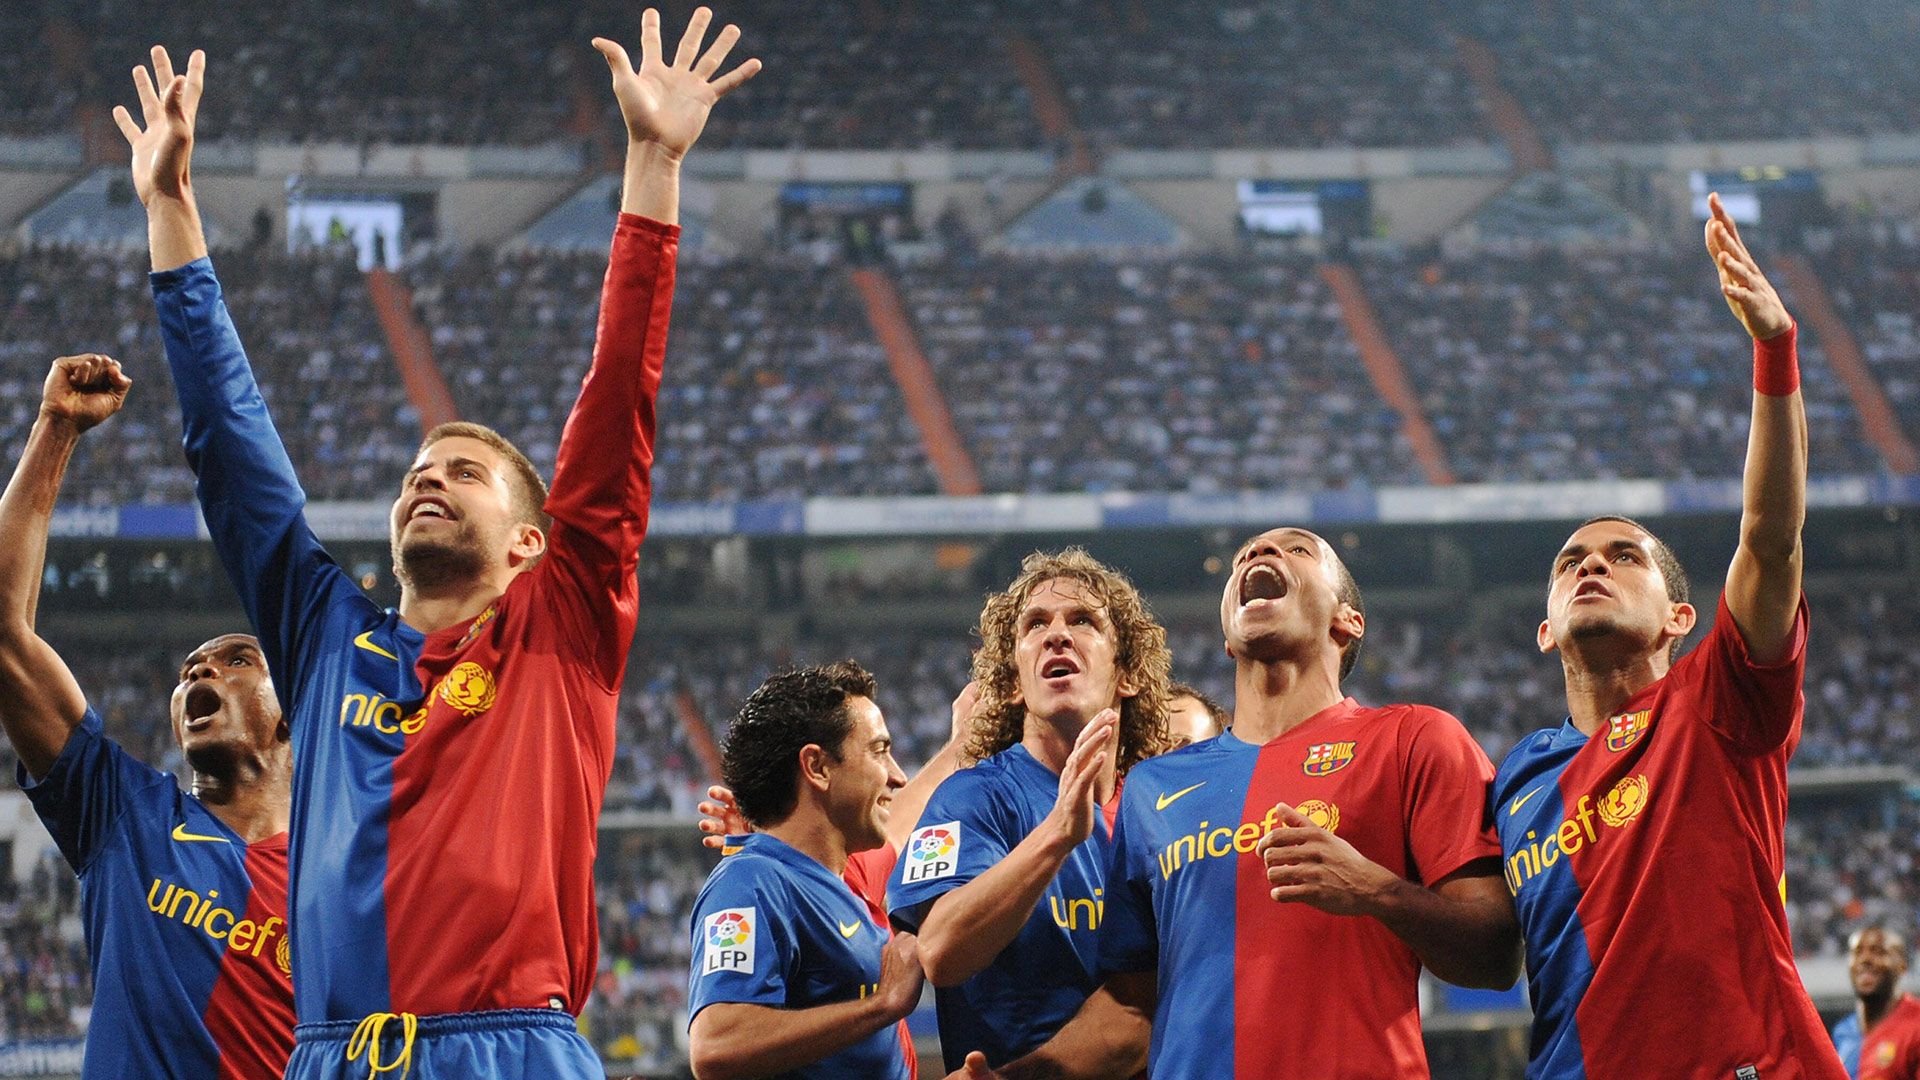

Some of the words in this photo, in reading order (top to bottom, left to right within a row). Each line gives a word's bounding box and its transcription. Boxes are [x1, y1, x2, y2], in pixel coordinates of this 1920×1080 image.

[909, 861, 950, 881] LFP
[1158, 807, 1279, 881] unicef
[1504, 795, 1597, 897] unicef
[147, 878, 283, 957] unicef
[709, 950, 748, 971] LFP
